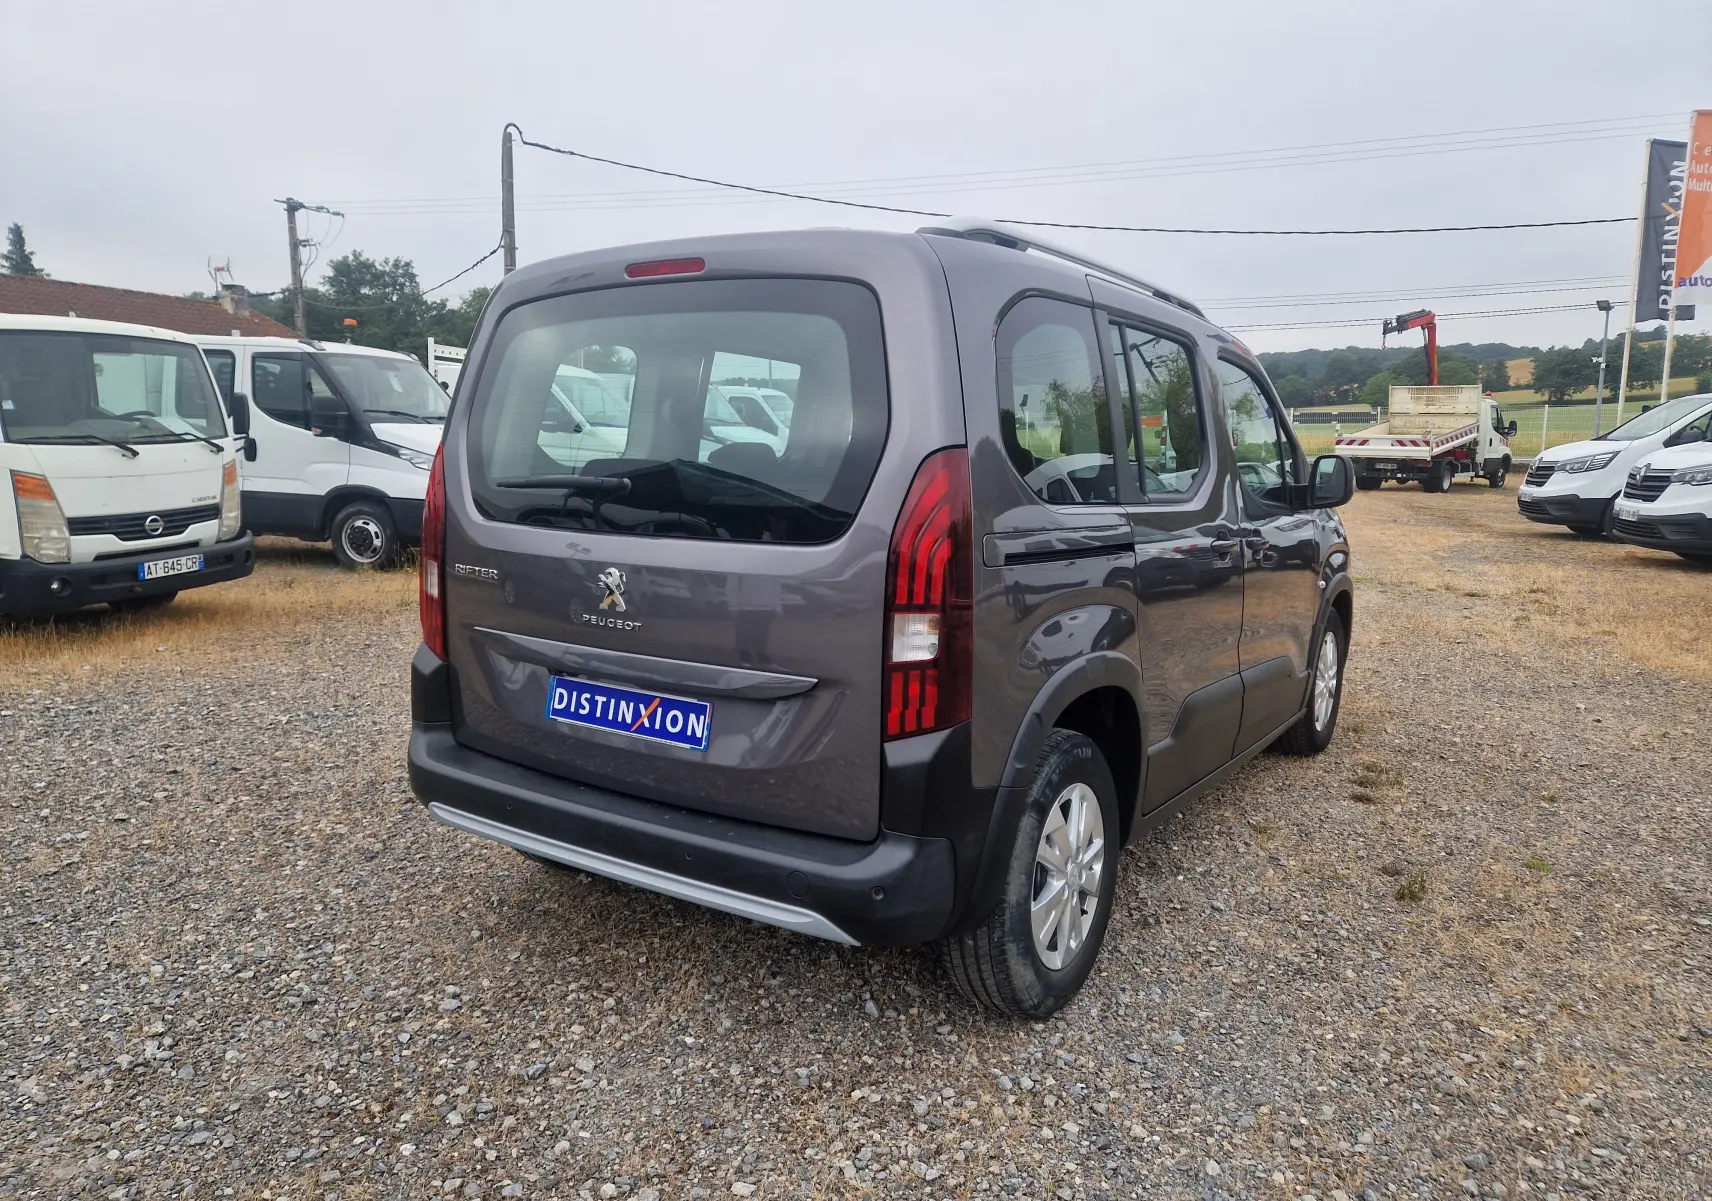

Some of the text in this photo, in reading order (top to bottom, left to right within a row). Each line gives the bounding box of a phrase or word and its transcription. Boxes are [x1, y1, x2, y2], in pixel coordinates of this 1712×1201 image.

[454, 563, 499, 580] RIFTER
[582, 613, 642, 632] PEUGEOT
[553, 687, 705, 738] DISTINXION
